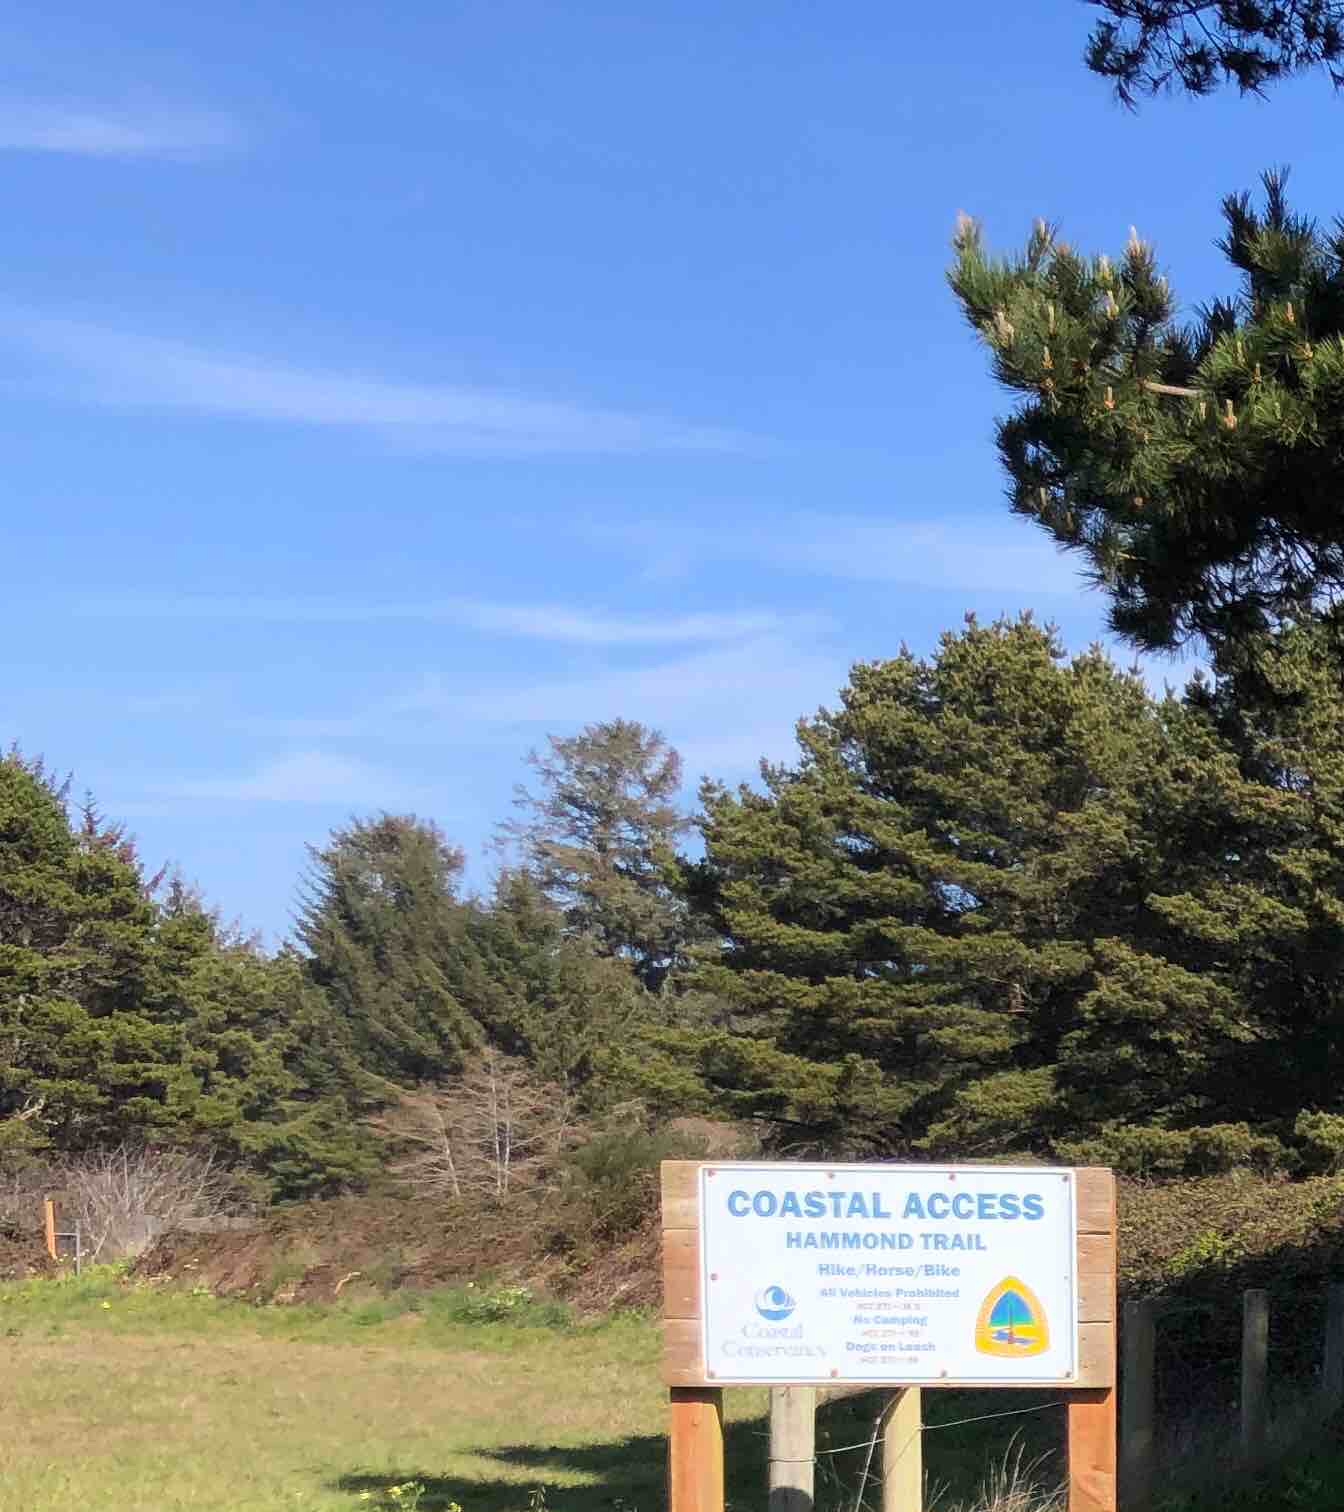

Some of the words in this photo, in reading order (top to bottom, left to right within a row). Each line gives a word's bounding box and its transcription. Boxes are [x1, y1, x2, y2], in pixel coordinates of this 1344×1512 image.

[727, 1190, 891, 1220] COASTAL
[902, 1192, 1045, 1221] ACCESS
[786, 1232, 914, 1250] HAMMOND
[921, 1233, 988, 1251] TRAIL
[818, 1263, 961, 1279] Hike/Horse/Bike
[819, 1288, 836, 1298] All
[840, 1288, 891, 1298] Vehicles
[895, 1288, 960, 1298] Prohibited
[873, 1315, 929, 1327] Camping
[846, 1342, 875, 1353] Dogs
[879, 1343, 896, 1352] on
